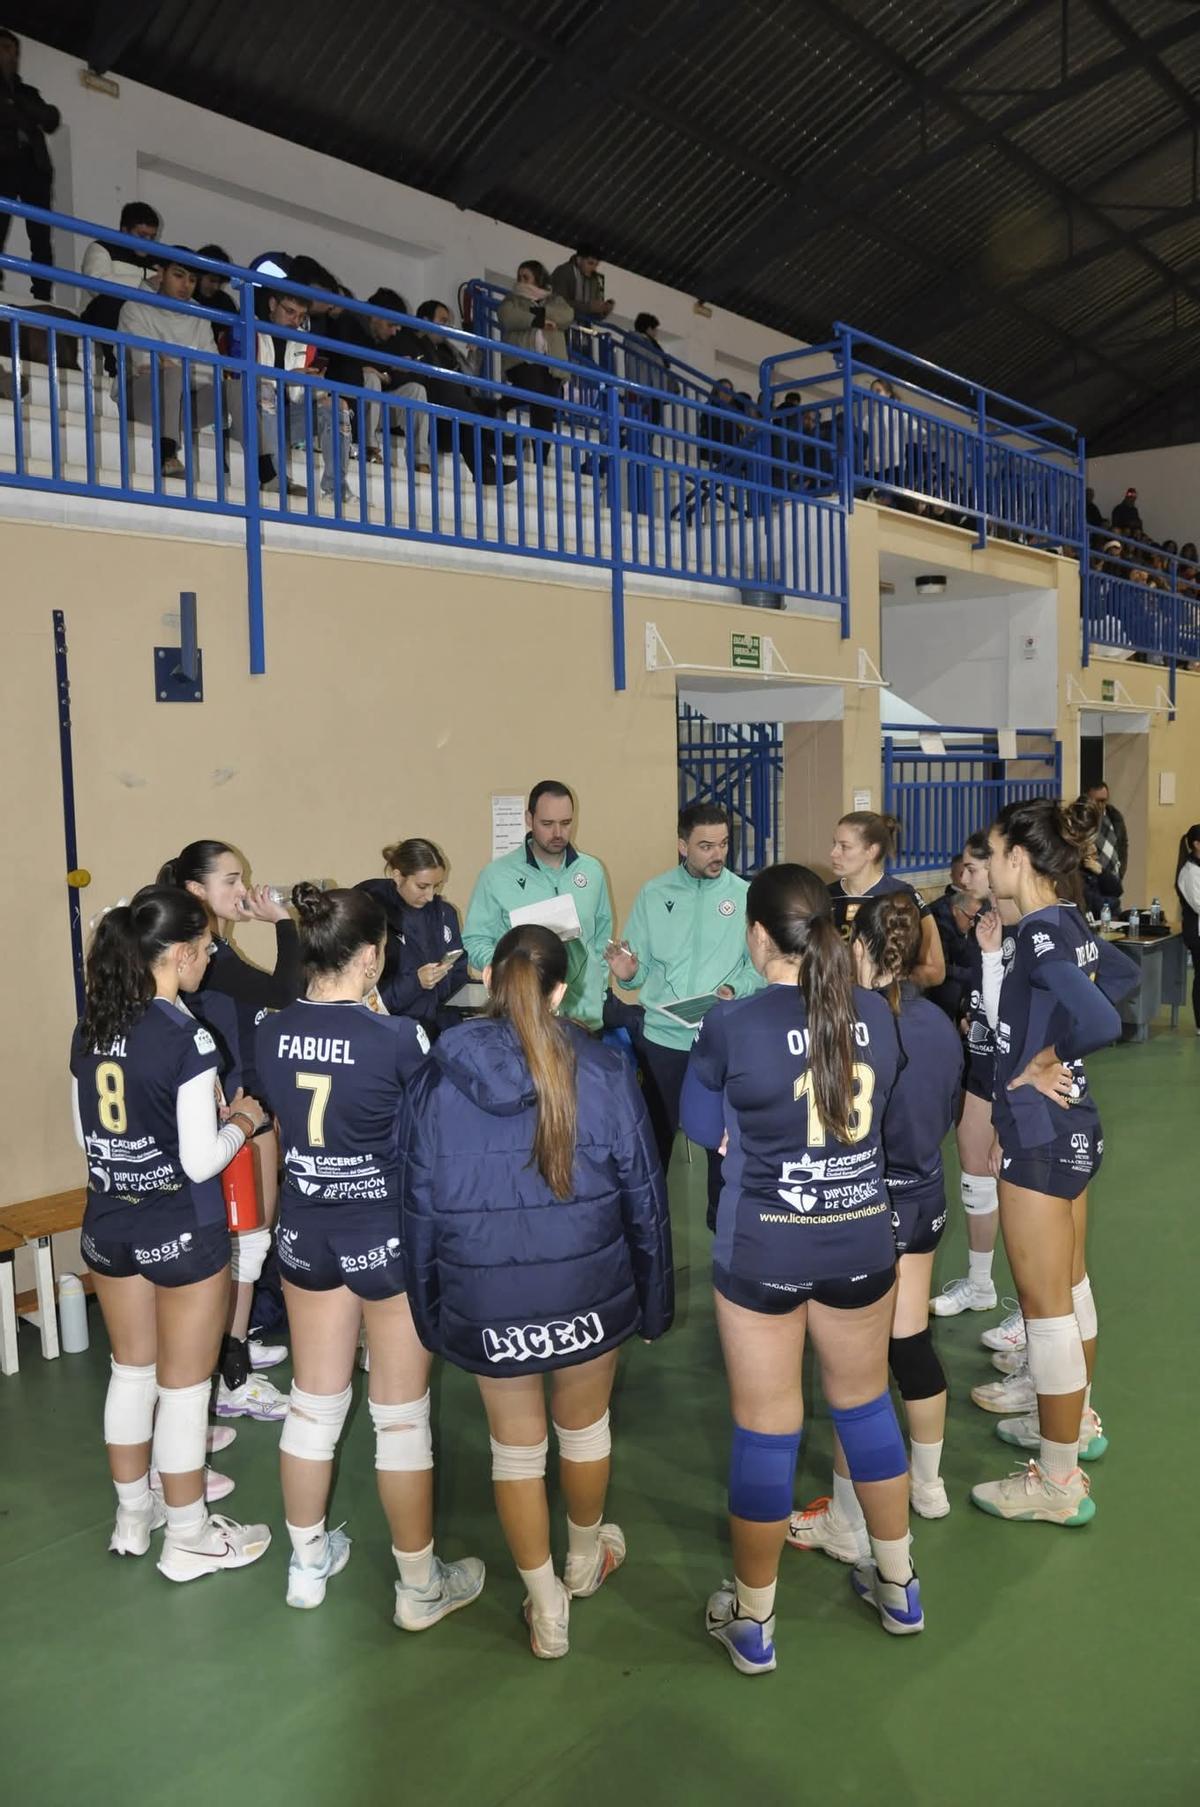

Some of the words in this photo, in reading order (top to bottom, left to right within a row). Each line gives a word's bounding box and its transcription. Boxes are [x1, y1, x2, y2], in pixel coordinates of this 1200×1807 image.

[278, 1035, 355, 1065] FABUEL
[96, 1061, 128, 1134] 8
[296, 1072, 332, 1147] 7
[113, 1164, 174, 1182] DIPUTACIÓN
[115, 1183, 129, 1191] DE
[825, 1201, 839, 1209] DE
